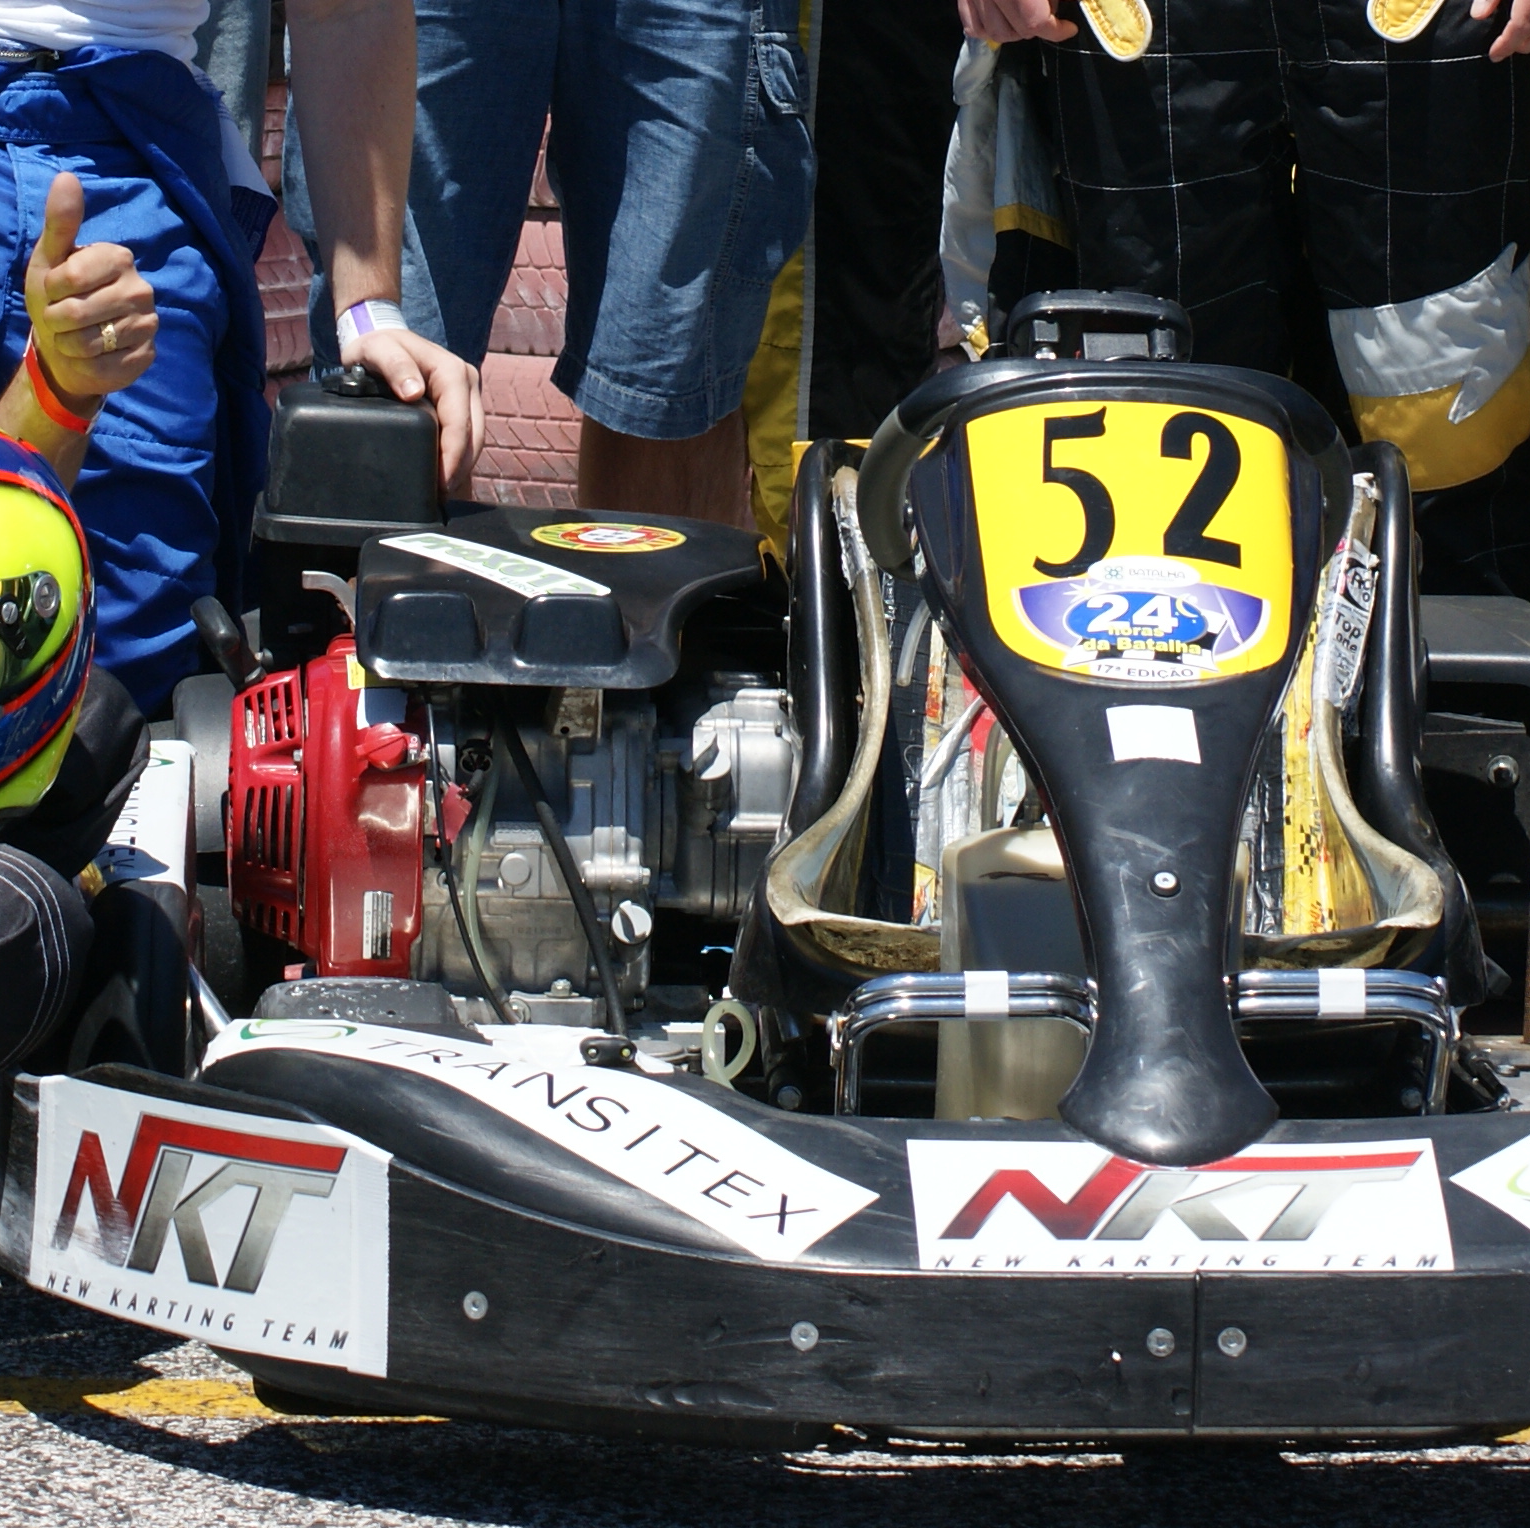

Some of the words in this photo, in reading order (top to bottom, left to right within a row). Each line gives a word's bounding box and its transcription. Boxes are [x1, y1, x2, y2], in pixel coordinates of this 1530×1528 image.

[1033, 406, 1241, 578] 52
[1128, 568, 1186, 579] BATALHA
[1086, 594, 1179, 633] 24
[1082, 637, 1110, 652] da
[1117, 638, 1203, 656] Batalha
[1127, 662, 1195, 680] EDIÇÃO
[369, 1038, 819, 1236] TRANSITEX
[51, 1110, 349, 1296] NKT
[938, 1151, 1425, 1241] NKT
[936, 1254, 1028, 1269] NEW
[1067, 1254, 1279, 1269] KARTING
[1322, 1254, 1439, 1269] TEAM
[46, 1271, 92, 1299] NEW
[109, 1287, 236, 1332] KARTING
[258, 1318, 349, 1350] TEAM
